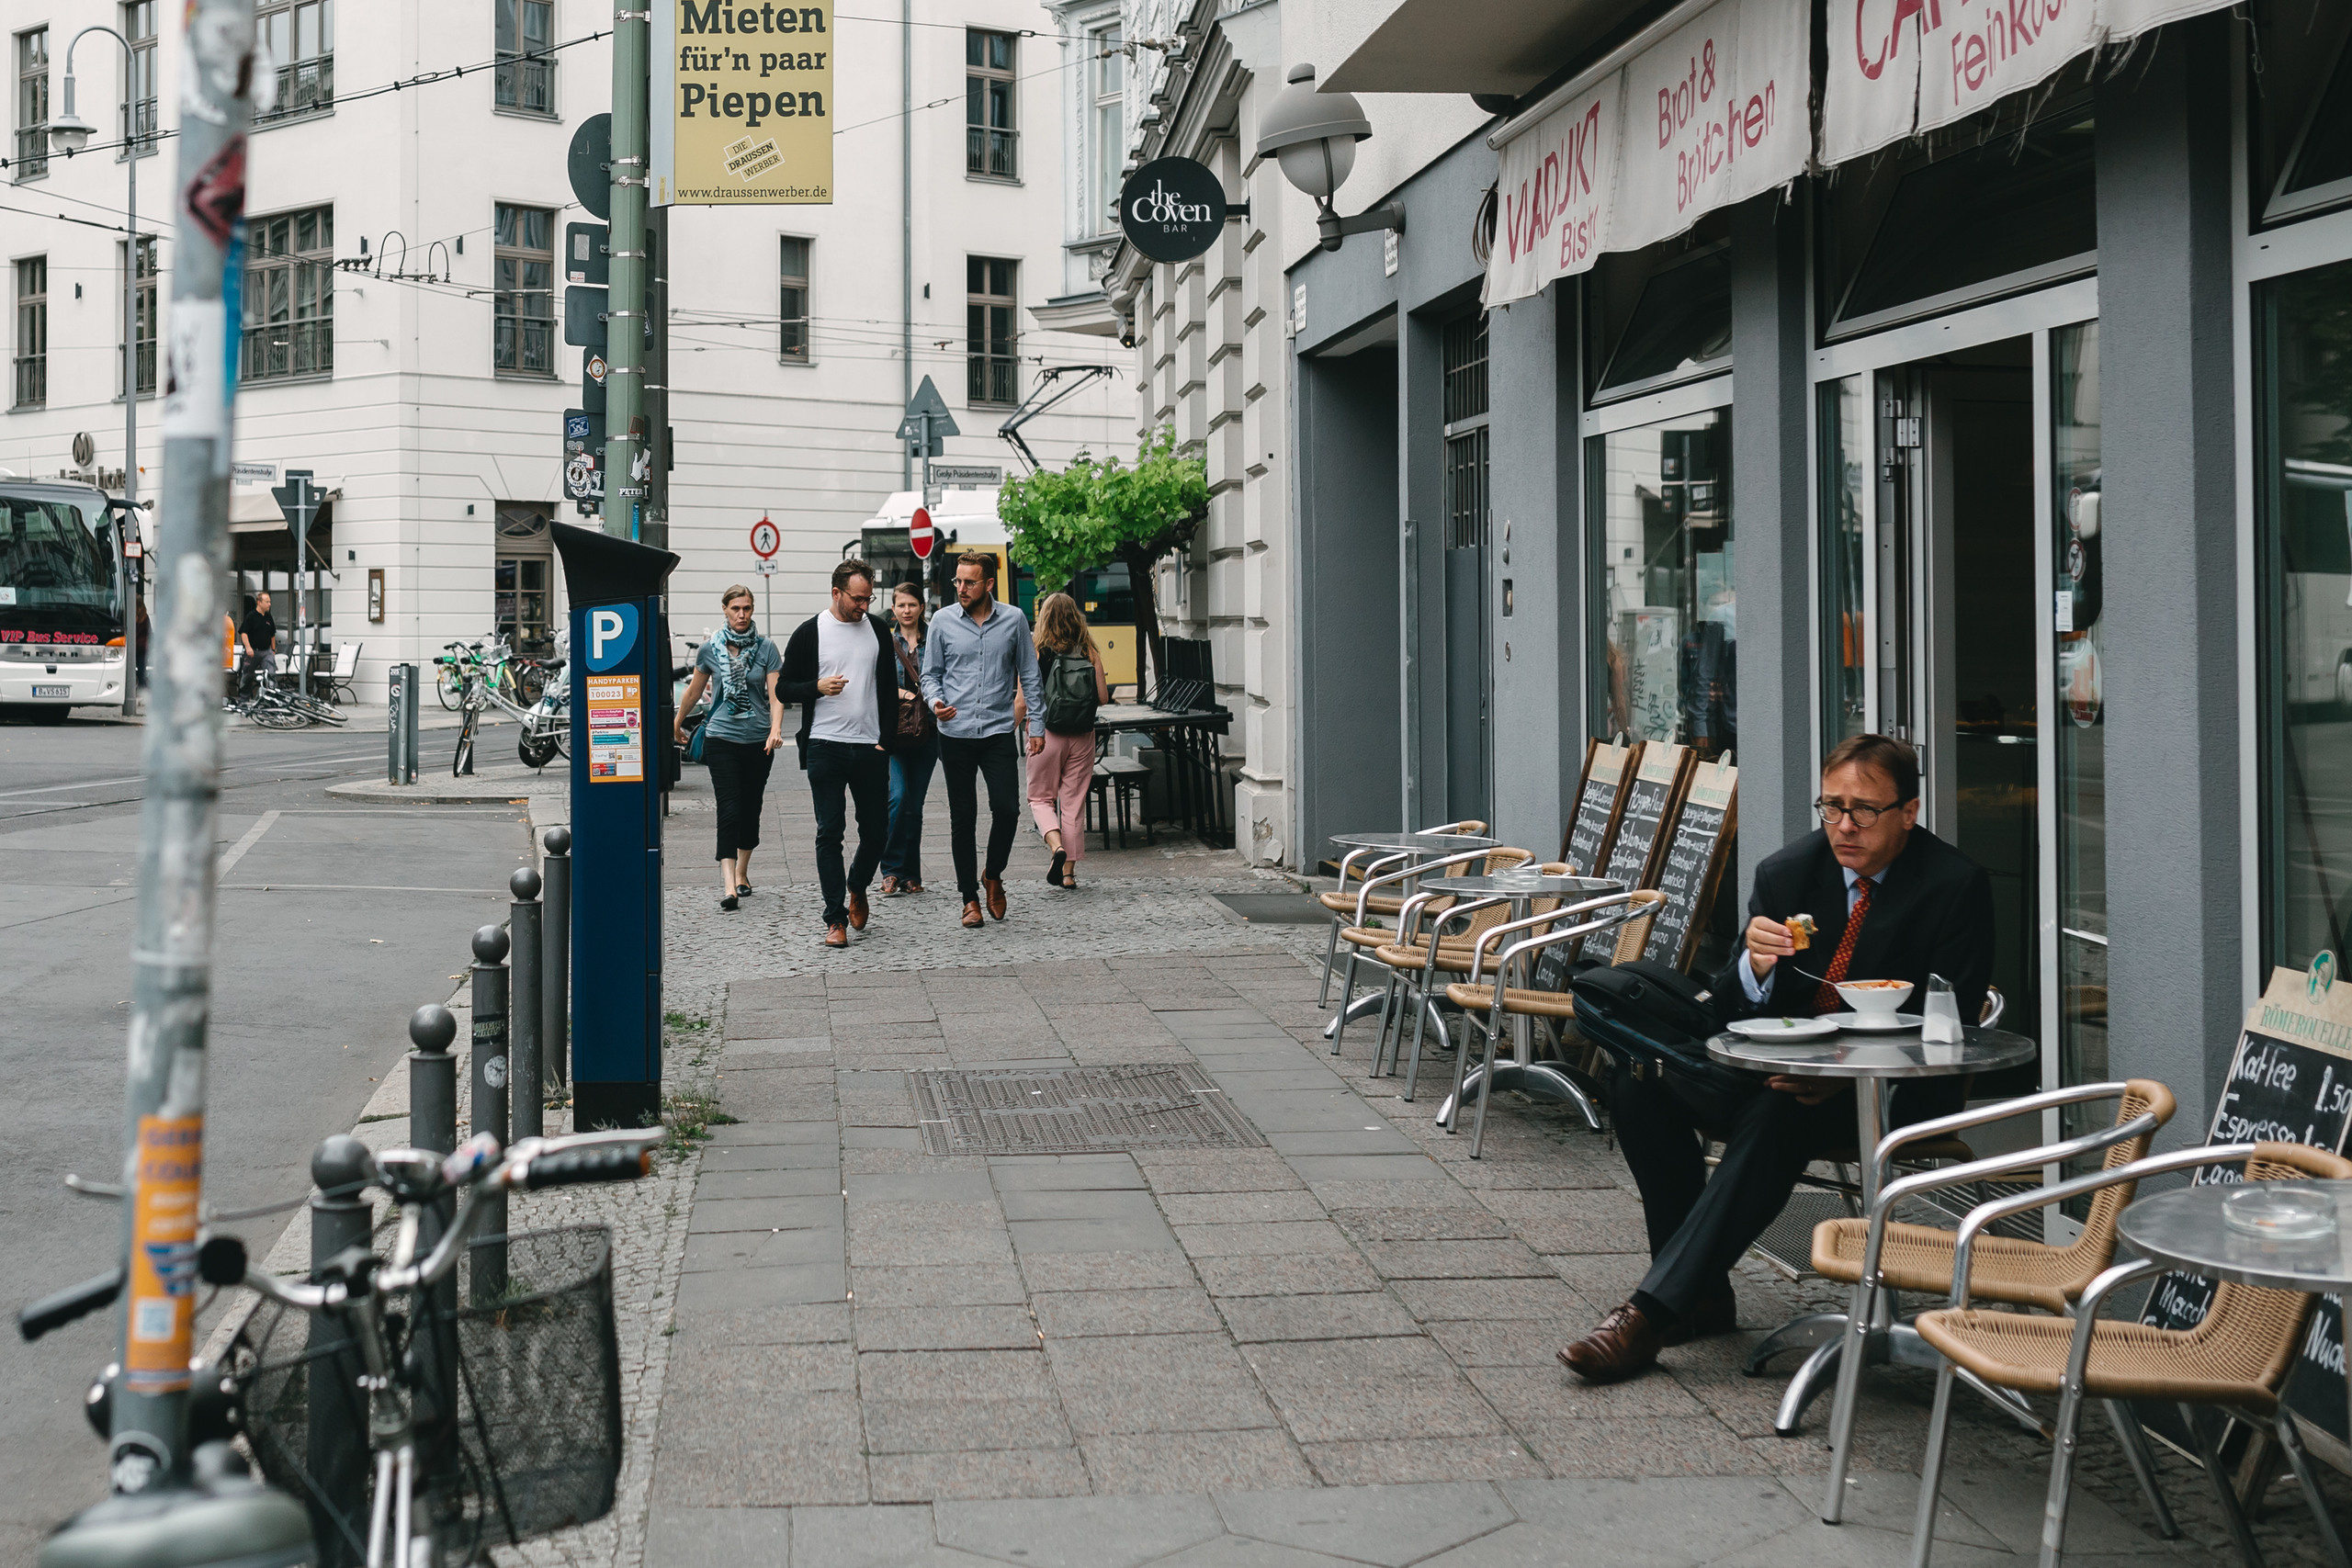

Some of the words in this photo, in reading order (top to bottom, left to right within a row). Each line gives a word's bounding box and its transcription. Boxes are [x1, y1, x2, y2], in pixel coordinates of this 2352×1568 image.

[681, 0, 826, 34] Mieten
[680, 46, 751, 72] für'n
[759, 51, 826, 77] paar
[681, 83, 826, 128] Piepen
[1658, 57, 1696, 150] Brot
[1701, 38, 1716, 103] &
[728, 142, 775, 172] DRAUSSEN
[732, 141, 749, 154] DIE
[743, 154, 781, 177] WERBER
[677, 186, 828, 198] www.draussenwerber.de
[1150, 179, 1182, 206] the
[1132, 197, 1213, 223] Coven
[1163, 223, 1188, 233] BAR
[936, 468, 952, 480] Große
[953, 468, 998, 481] Präsidentenstraße
[0, 630, 24, 642] VIP
[27, 630, 51, 643] Bus
[52, 631, 98, 644] Service
[593, 611, 624, 660] P
[588, 677, 639, 685] HANDYPARKEN
[591, 690, 621, 698] 100023
[1535, 956, 1555, 988] Lachs
[2232, 1034, 2297, 1091] Kaffee
[2314, 1066, 2352, 1114] 1.50
[2159, 1279, 2211, 1324] Macch
